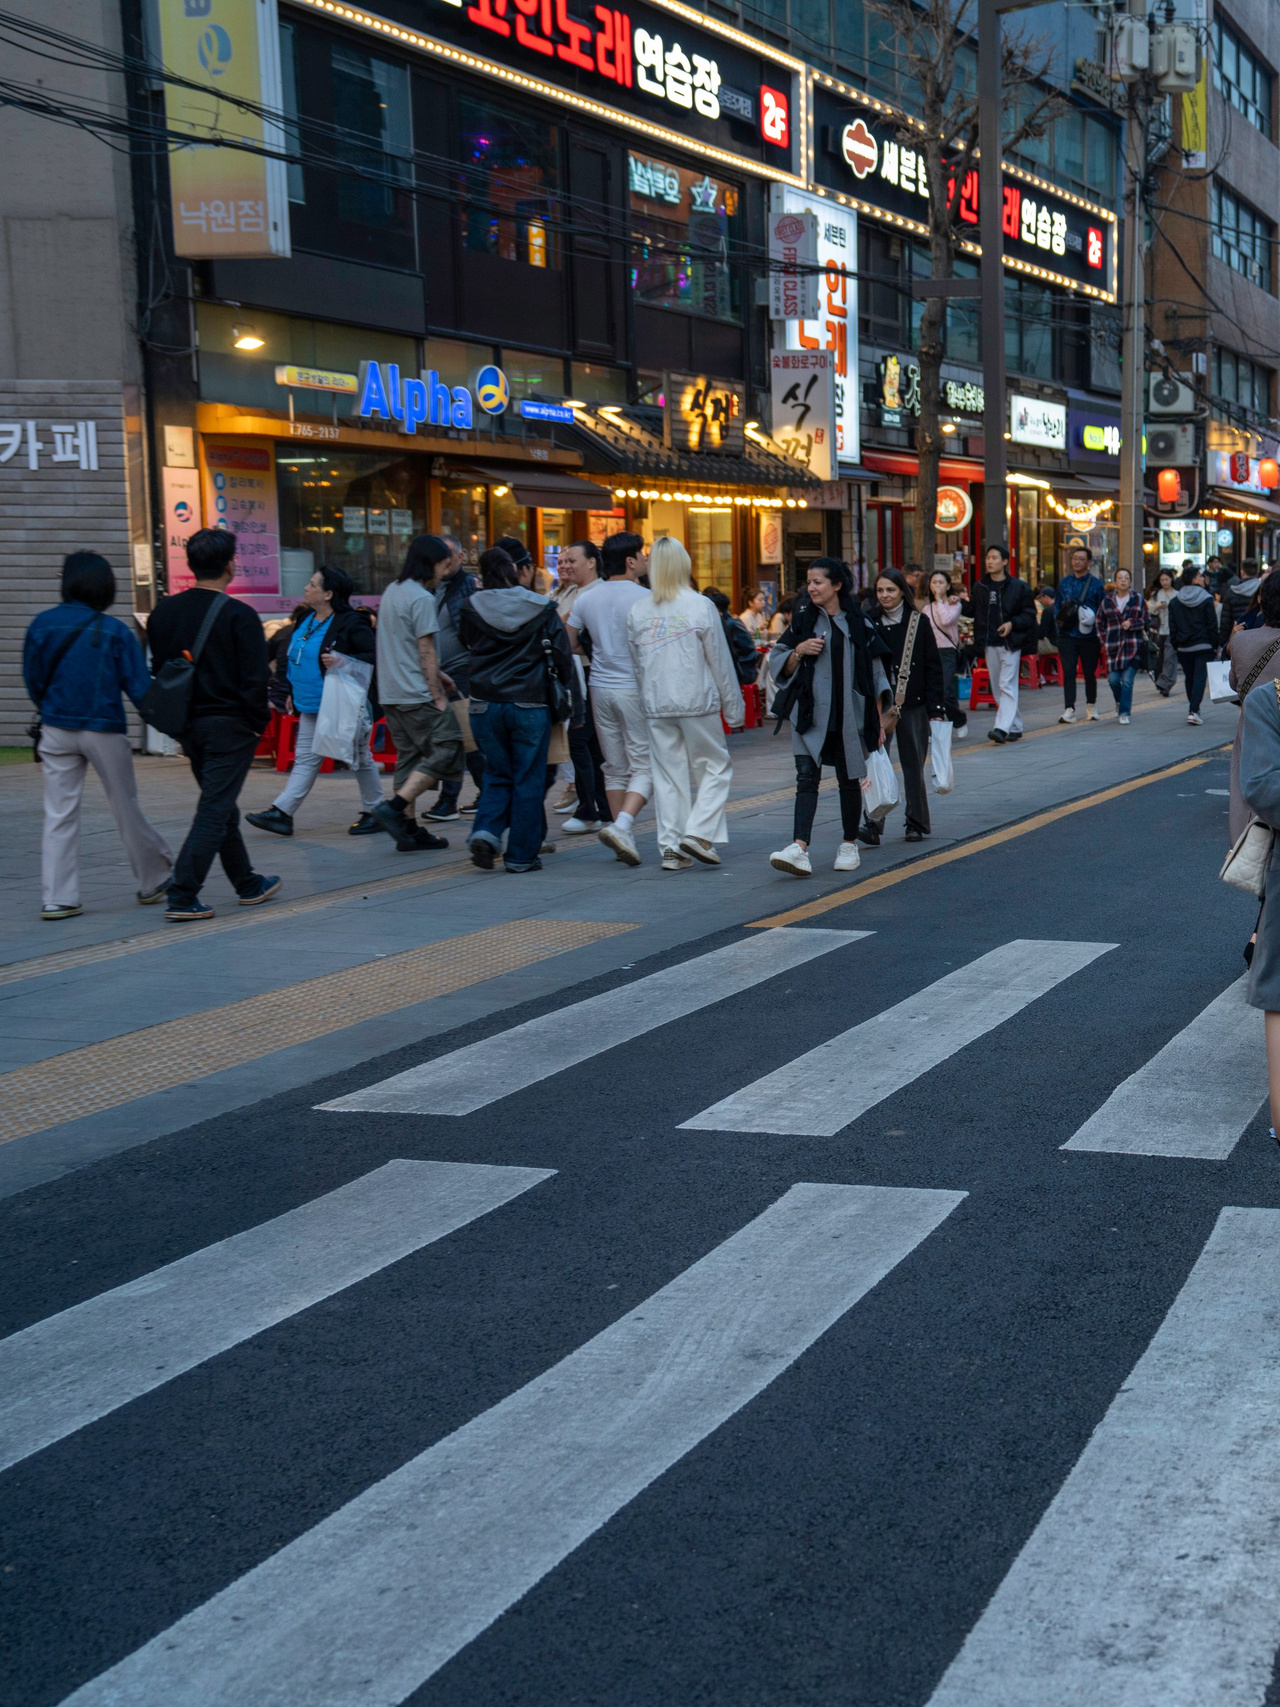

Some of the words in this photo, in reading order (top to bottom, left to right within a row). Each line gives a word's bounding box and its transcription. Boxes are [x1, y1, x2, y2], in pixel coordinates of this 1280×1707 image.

[634, 27, 722, 120] 연습장
[763, 91, 787, 141] 2F
[179, 200, 266, 233] 낙원점
[1021, 198, 1067, 256] 연습장
[824, 222, 847, 248] 세븐틴
[783, 247, 798, 278] FIRT
[783, 280, 798, 316] CLASS
[825, 258, 847, 318] 인
[773, 355, 828, 369] 숯불화로구이
[360, 360, 473, 434] Alpha
[524, 405, 572, 418] www.alpha.co.kr
[0, 420, 99, 470] 카페
[171, 536, 189, 549] Alp
